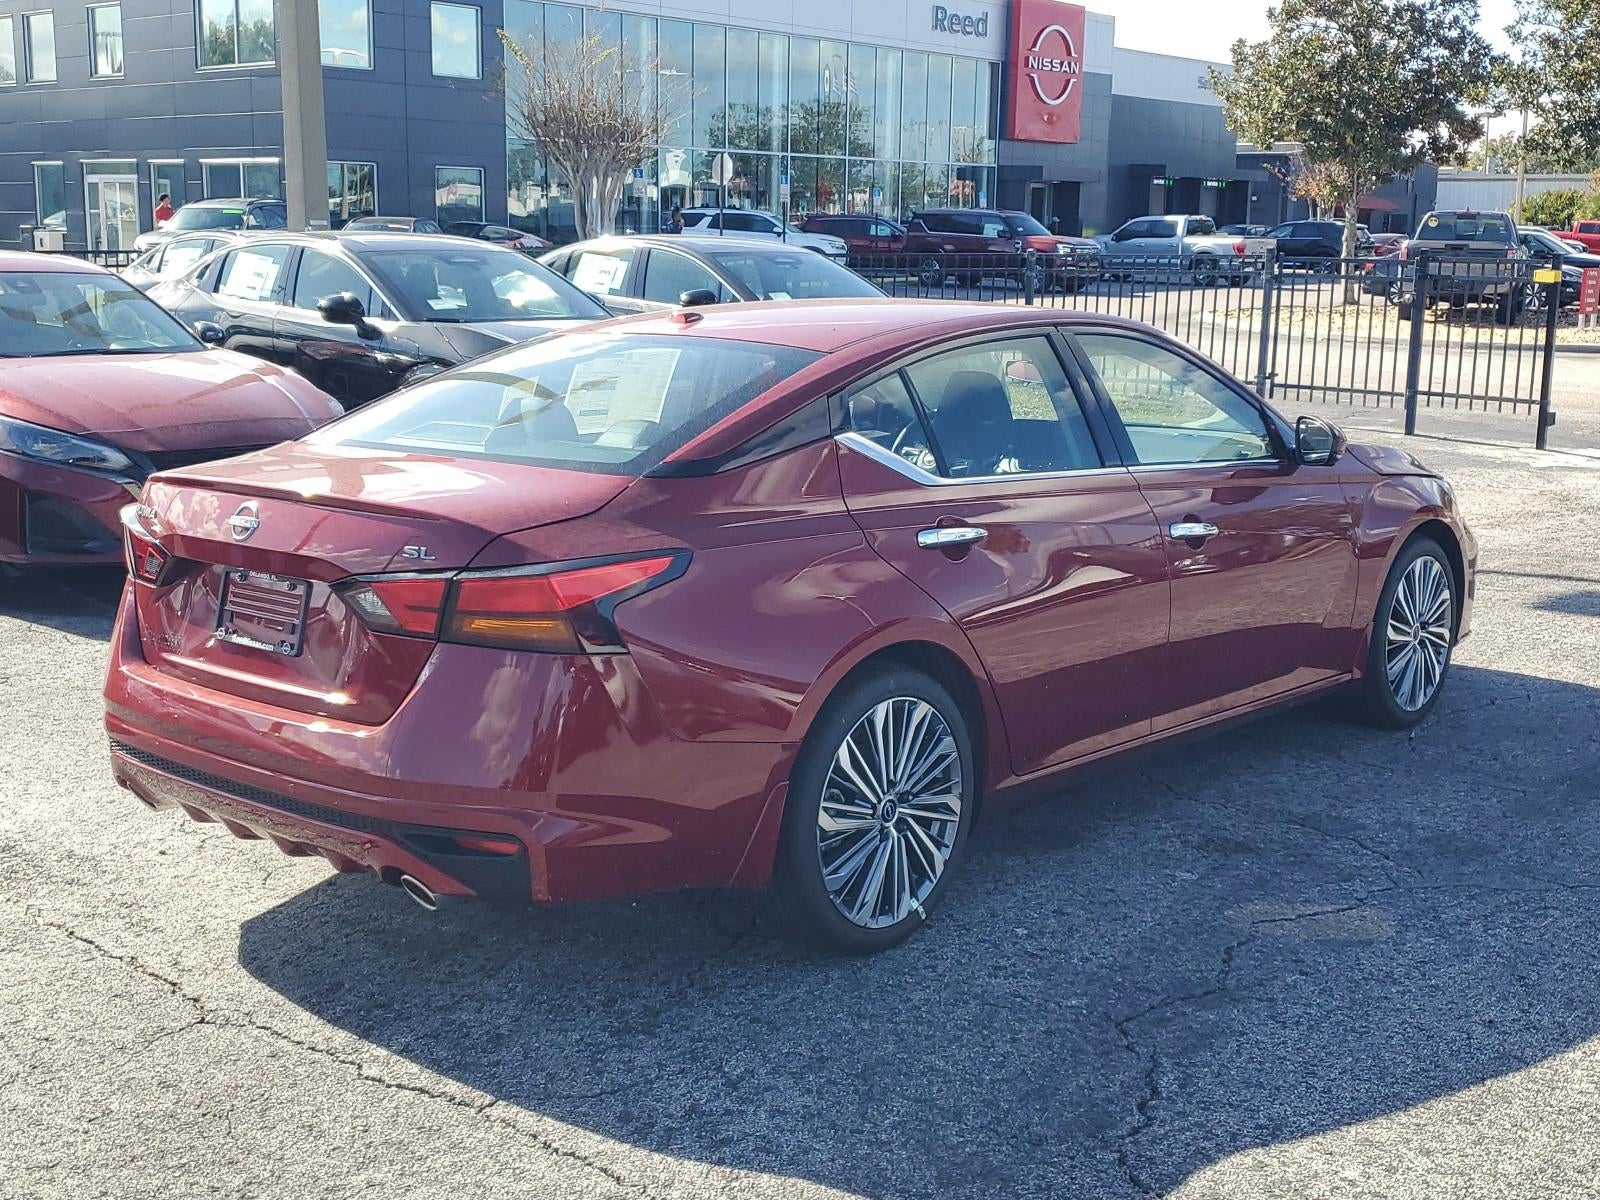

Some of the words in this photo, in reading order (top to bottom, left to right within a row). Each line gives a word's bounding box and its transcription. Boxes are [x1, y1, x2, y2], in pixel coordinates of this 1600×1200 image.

[933, 5, 989, 38] Reed
[1028, 55, 1080, 74] NISSAN
[402, 545, 437, 560] SL
